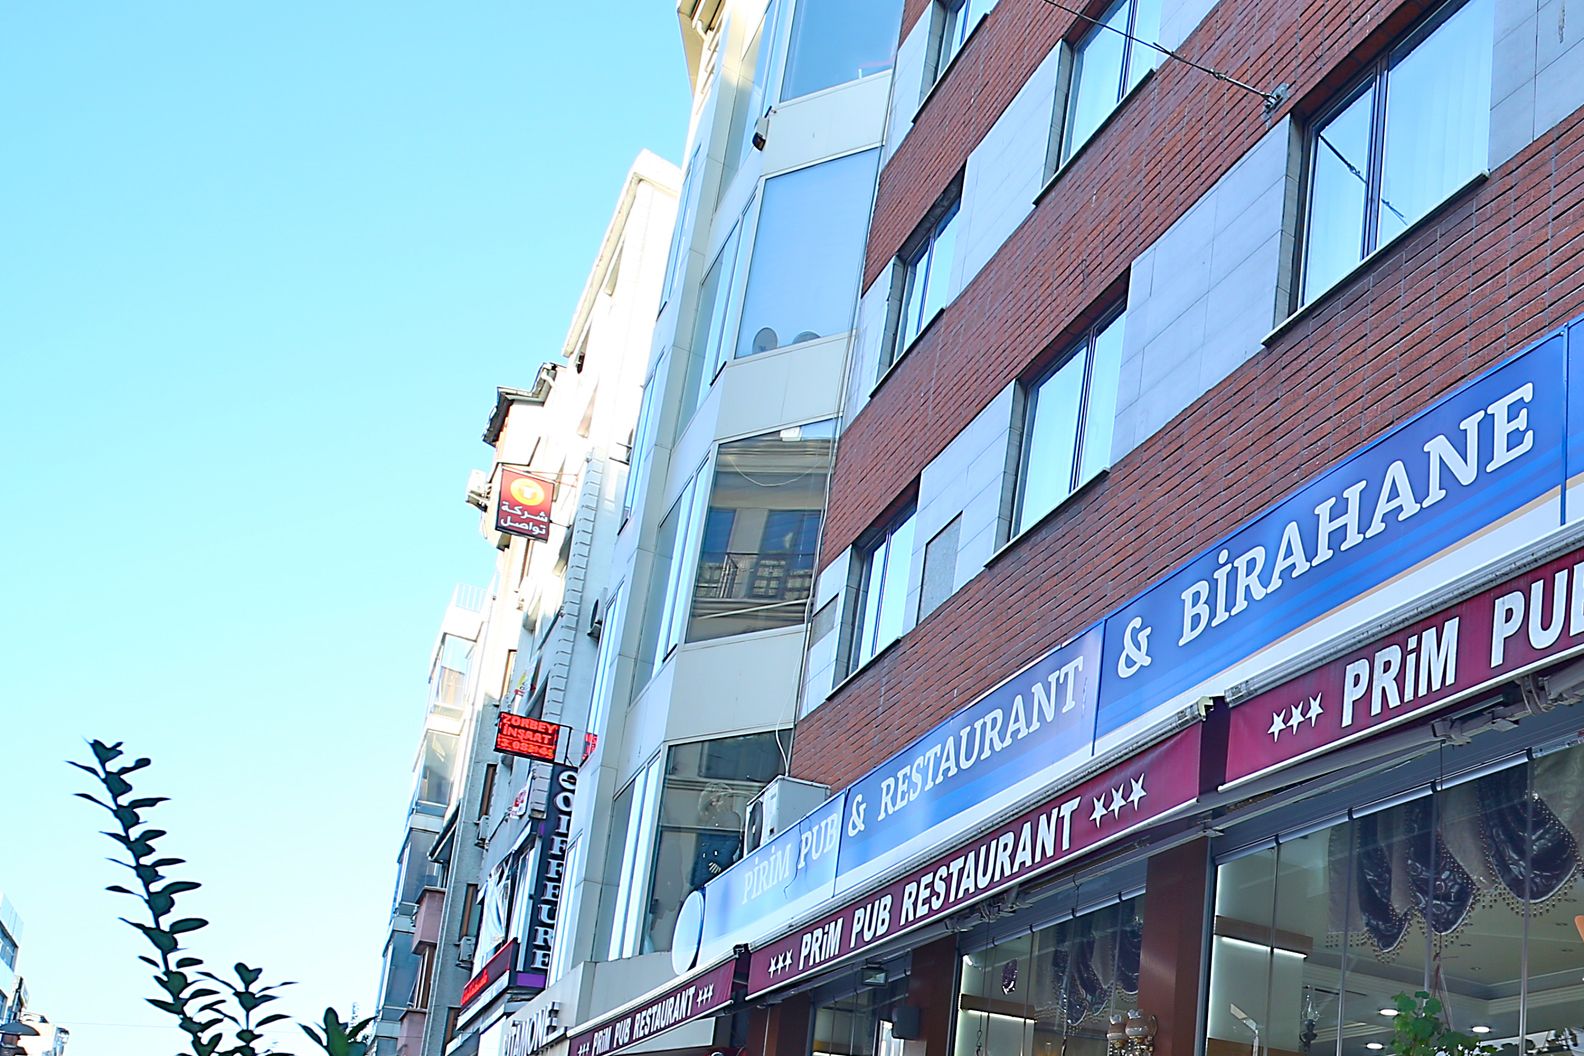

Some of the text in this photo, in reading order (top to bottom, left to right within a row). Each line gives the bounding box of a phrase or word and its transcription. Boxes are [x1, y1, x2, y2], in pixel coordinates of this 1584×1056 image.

[501, 501, 548, 522] شركة
[501, 516, 546, 534] تواصل
[797, 813, 838, 869] PUB
[847, 793, 867, 838] &
[877, 656, 1084, 822] RESTAURANT
[1117, 616, 1152, 679] &
[1177, 382, 1536, 647] BİRAHANE
[501, 713, 557, 733] ZORBEY
[850, 894, 892, 949] PUB
[900, 796, 1081, 926] RESTAURANT
[613, 1012, 632, 1048] PUB
[633, 985, 697, 1040] RESTAURANT
